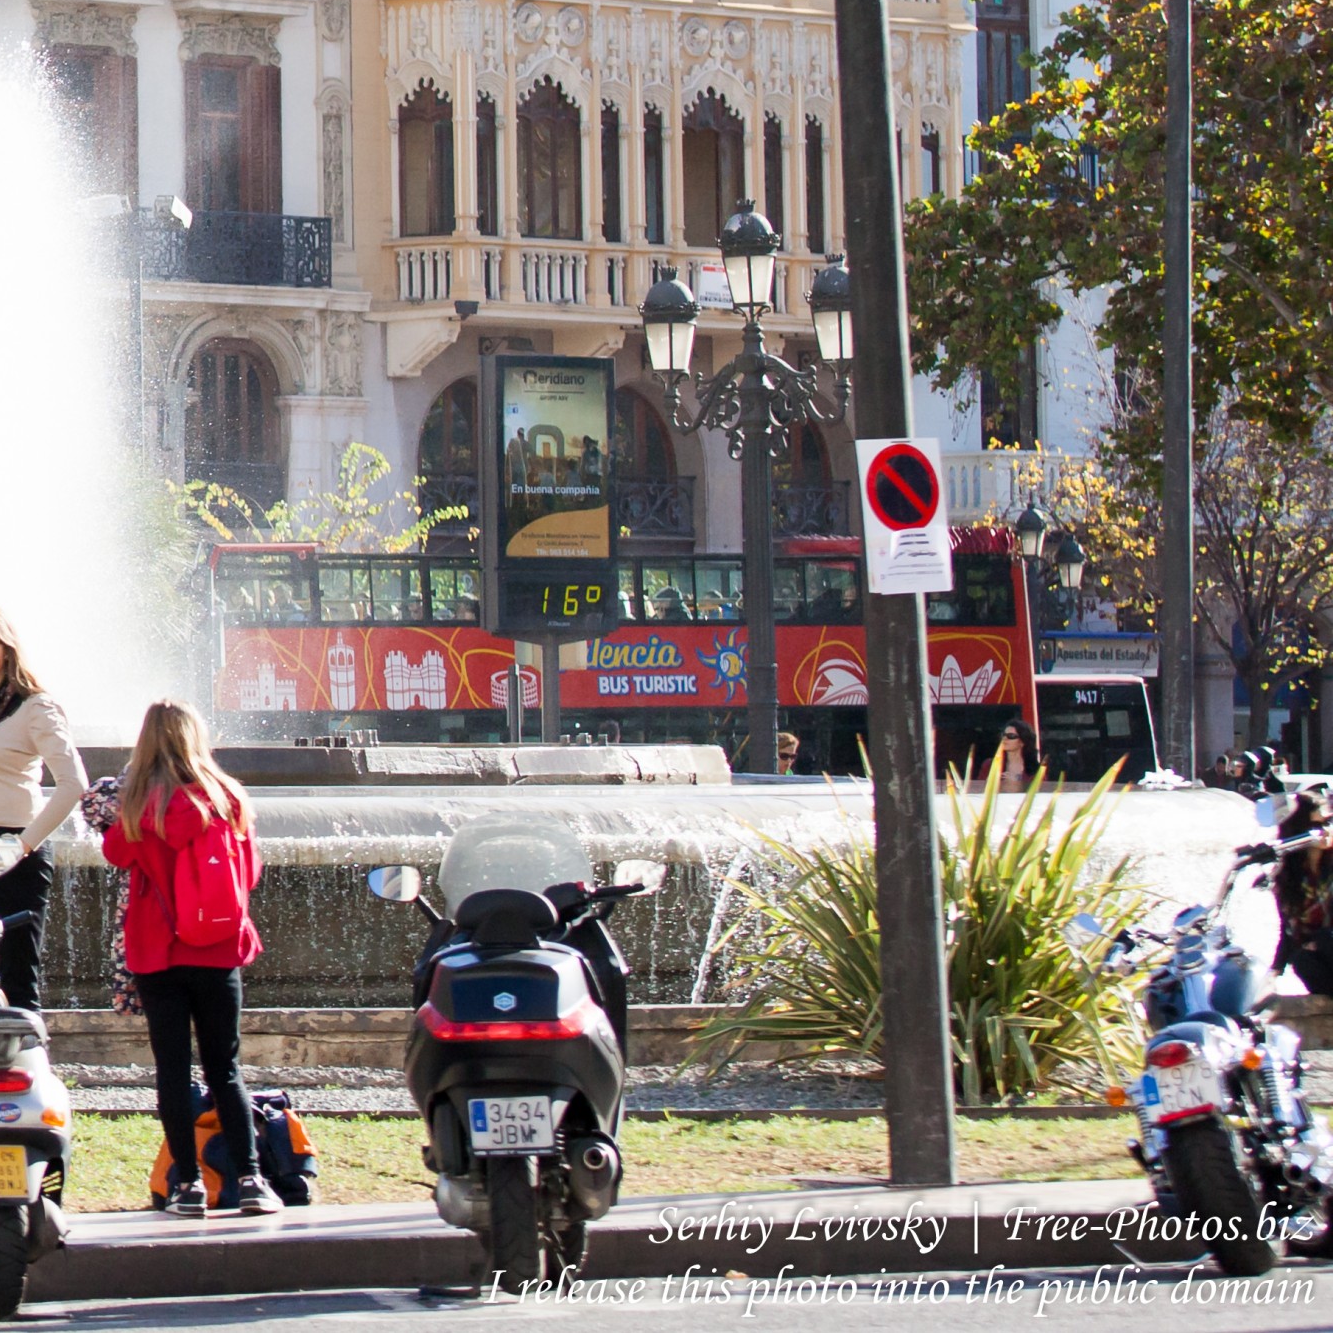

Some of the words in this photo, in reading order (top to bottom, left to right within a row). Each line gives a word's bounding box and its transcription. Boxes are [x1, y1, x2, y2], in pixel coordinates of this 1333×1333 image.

[511, 483, 523, 494] En
[525, 484, 553, 495] buena
[586, 637, 683, 669] lencia
[1057, 649, 1098, 662] Apuestas
[1100, 648, 1113, 660] del
[598, 676, 630, 694] BUS
[633, 675, 697, 694] TURISTIC
[1075, 690, 1098, 705] 9417
[489, 1101, 545, 1123] 3434
